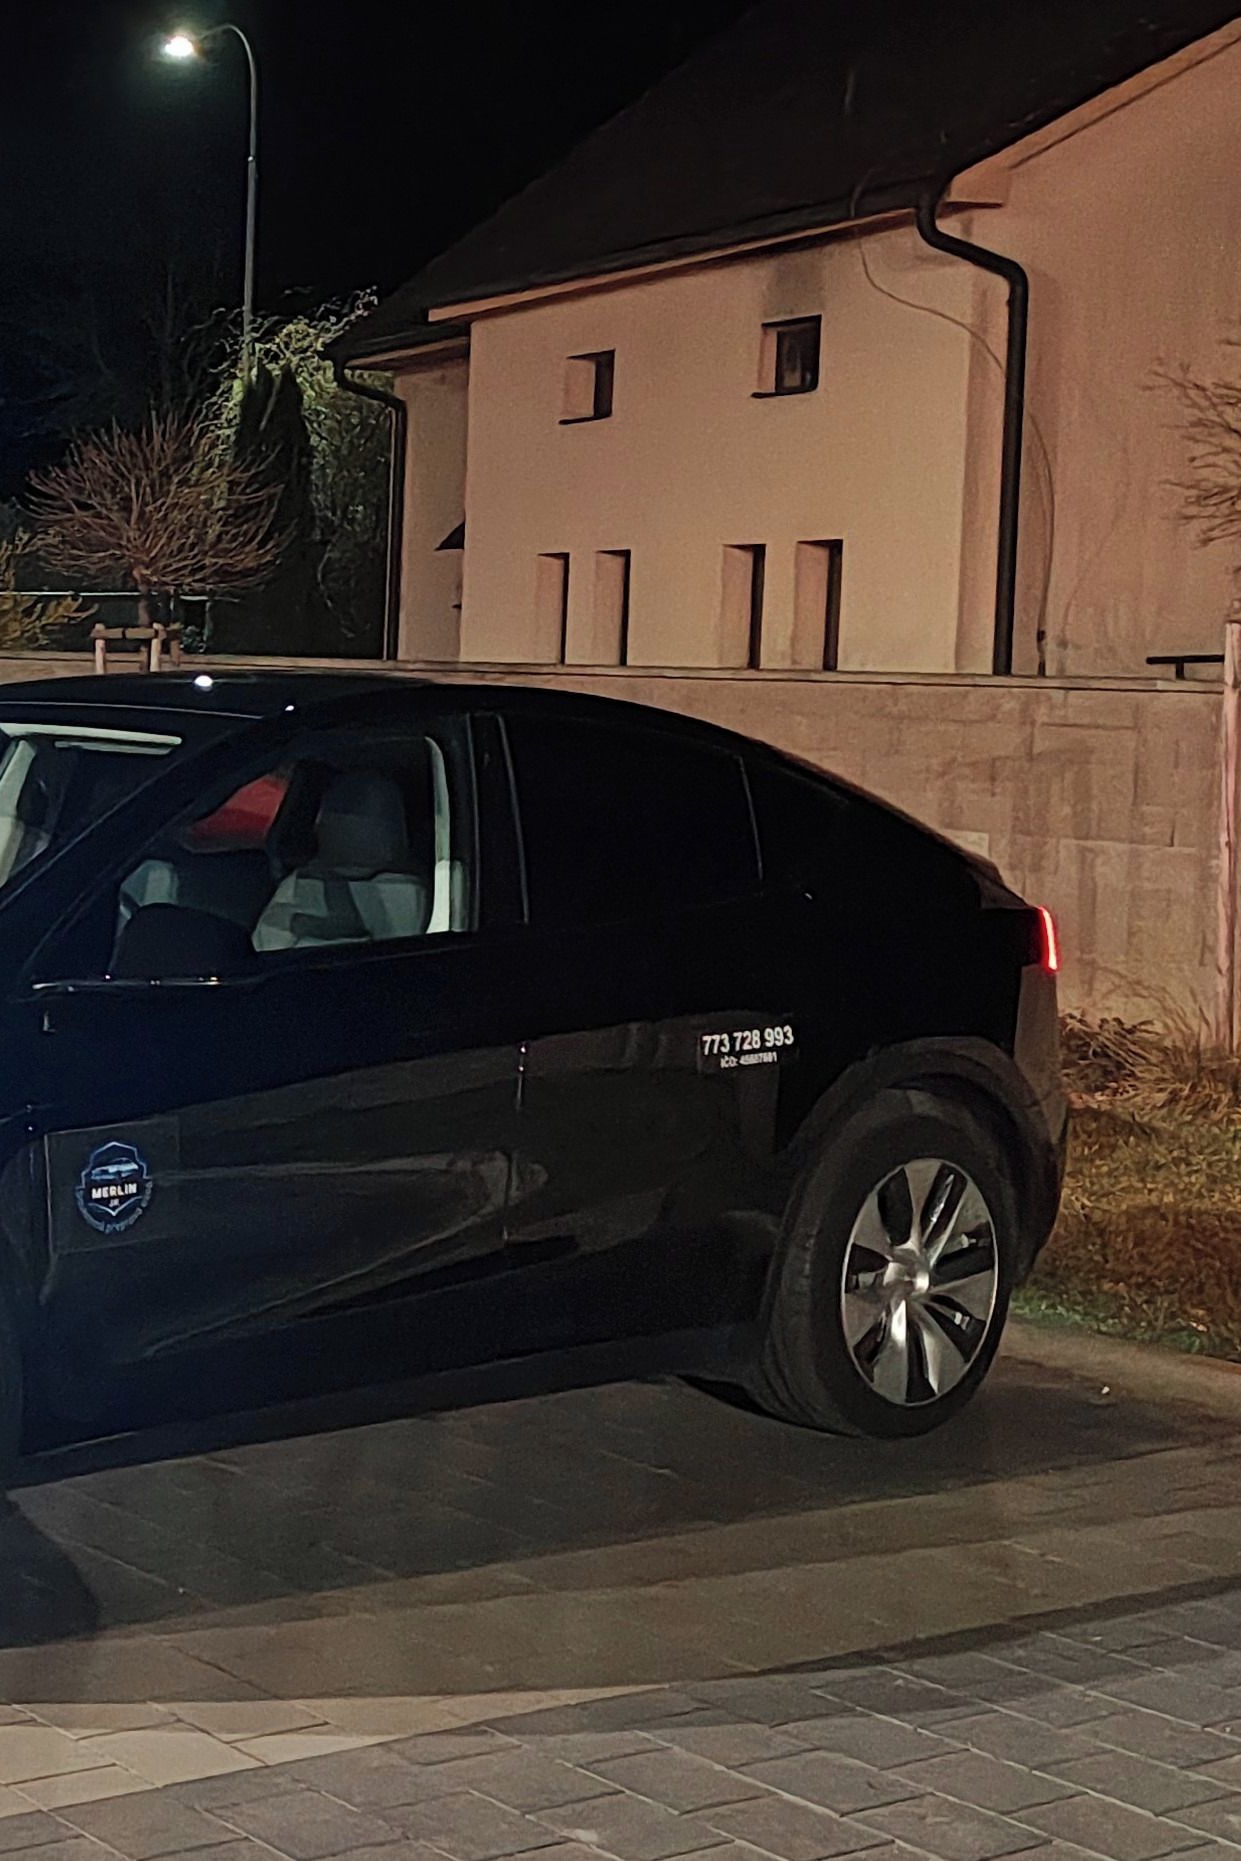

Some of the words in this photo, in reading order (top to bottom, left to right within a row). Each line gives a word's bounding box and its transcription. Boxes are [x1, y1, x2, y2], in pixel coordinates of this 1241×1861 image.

[702, 1033, 730, 1055] 773
[733, 1029, 761, 1051] 728
[764, 1024, 794, 1047] 993
[91, 1183, 137, 1199] MERLIN
